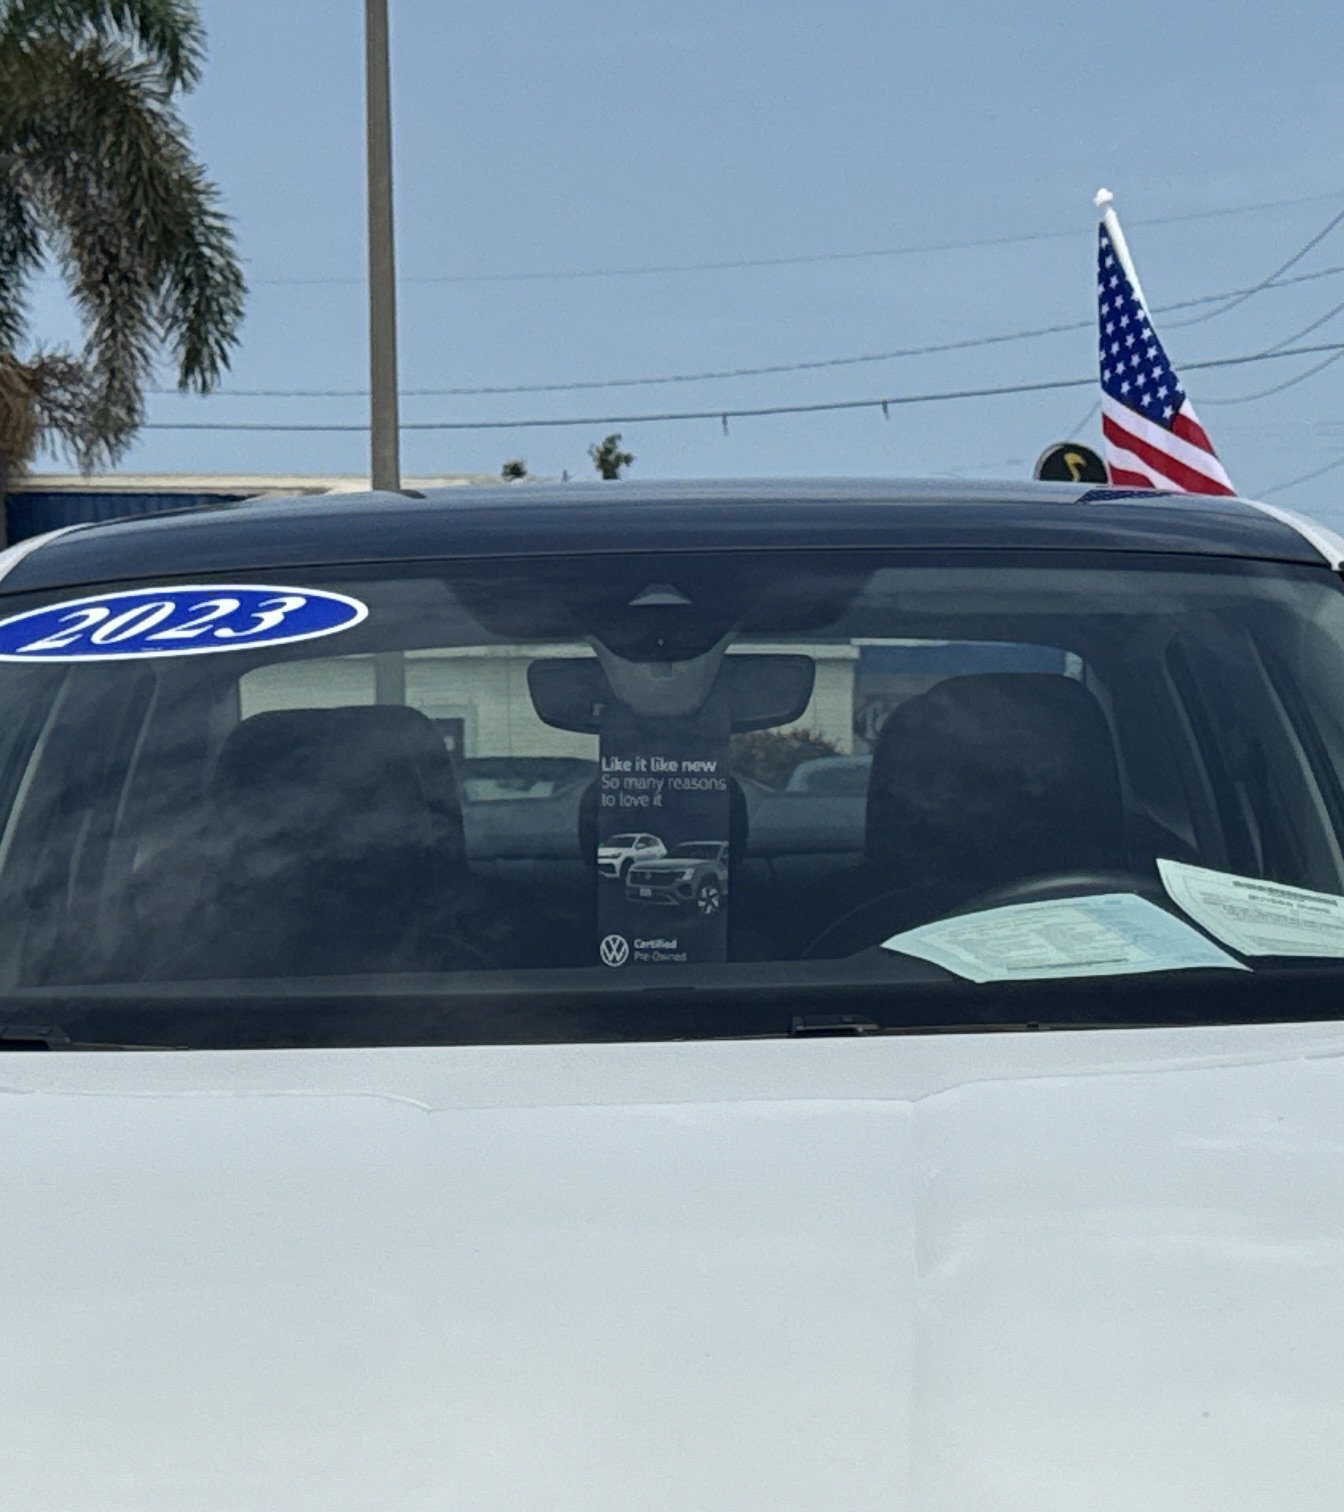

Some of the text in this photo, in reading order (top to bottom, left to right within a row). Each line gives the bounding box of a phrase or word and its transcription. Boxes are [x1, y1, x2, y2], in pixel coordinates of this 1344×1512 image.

[15, 596, 307, 653] 2023
[601, 756, 717, 772] Like it like new
[601, 773, 727, 793] So many reasons
[601, 793, 616, 807] to
[619, 791, 650, 807] love
